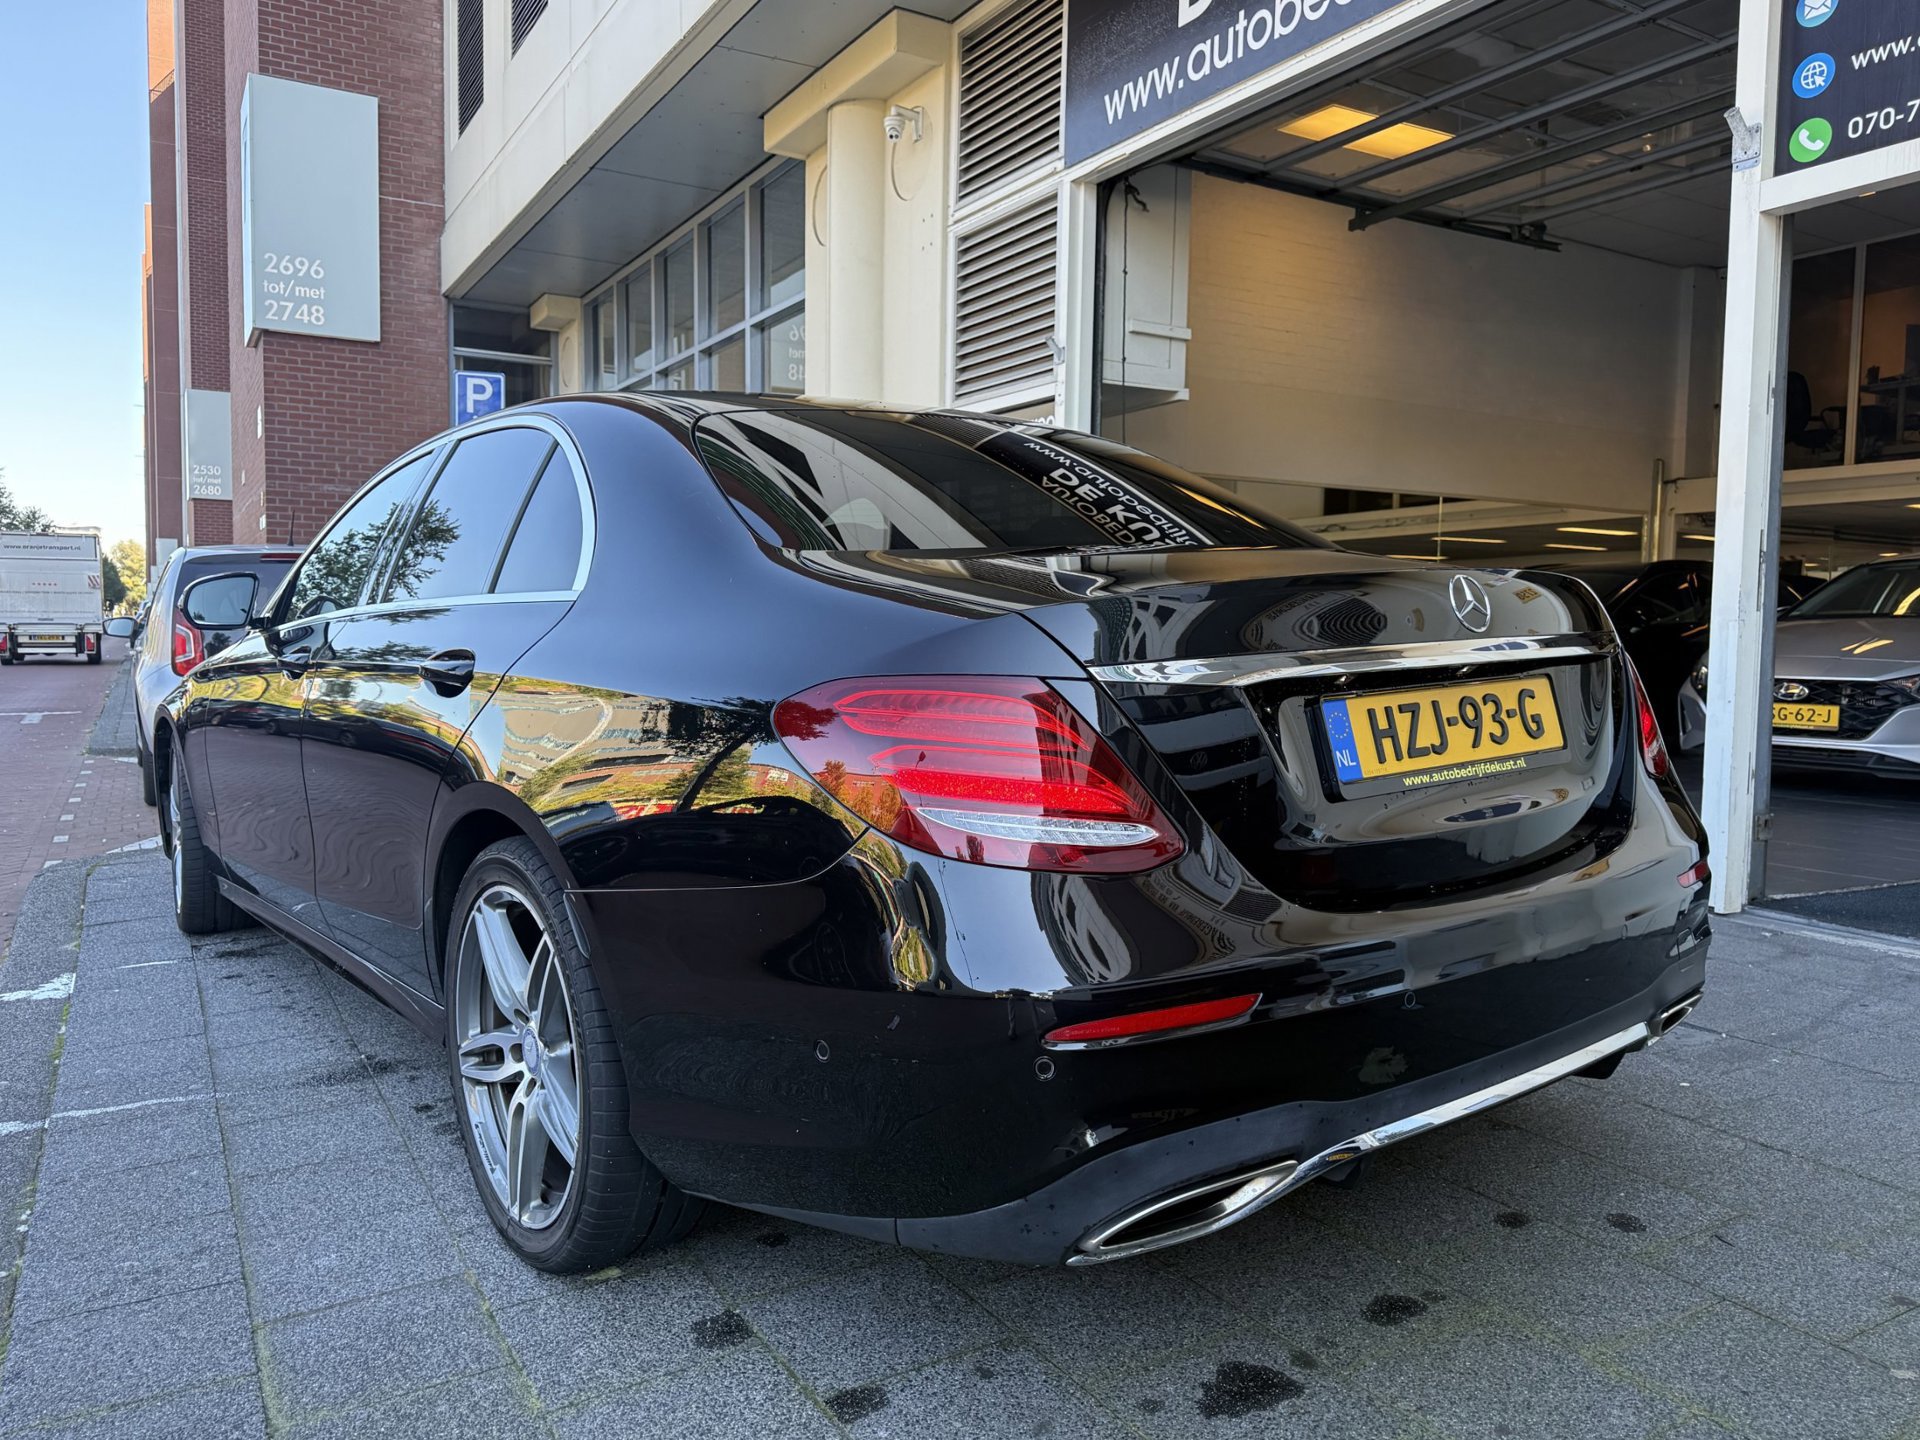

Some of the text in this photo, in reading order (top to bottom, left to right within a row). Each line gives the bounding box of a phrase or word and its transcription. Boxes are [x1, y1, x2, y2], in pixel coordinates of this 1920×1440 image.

[1104, 0, 1362, 125] www.autobe
[1851, 36, 1920, 70] www.
[264, 252, 325, 279] 2696
[263, 279, 325, 300] tot/met
[264, 299, 325, 325] 2748
[466, 377, 493, 413] P
[193, 465, 221, 475] 2530
[193, 485, 221, 495] 2680
[1367, 688, 1546, 764] HZJ-93-G
[1336, 749, 1357, 768] NL
[1403, 757, 1527, 787] www.autobedrijfdekust.nl
